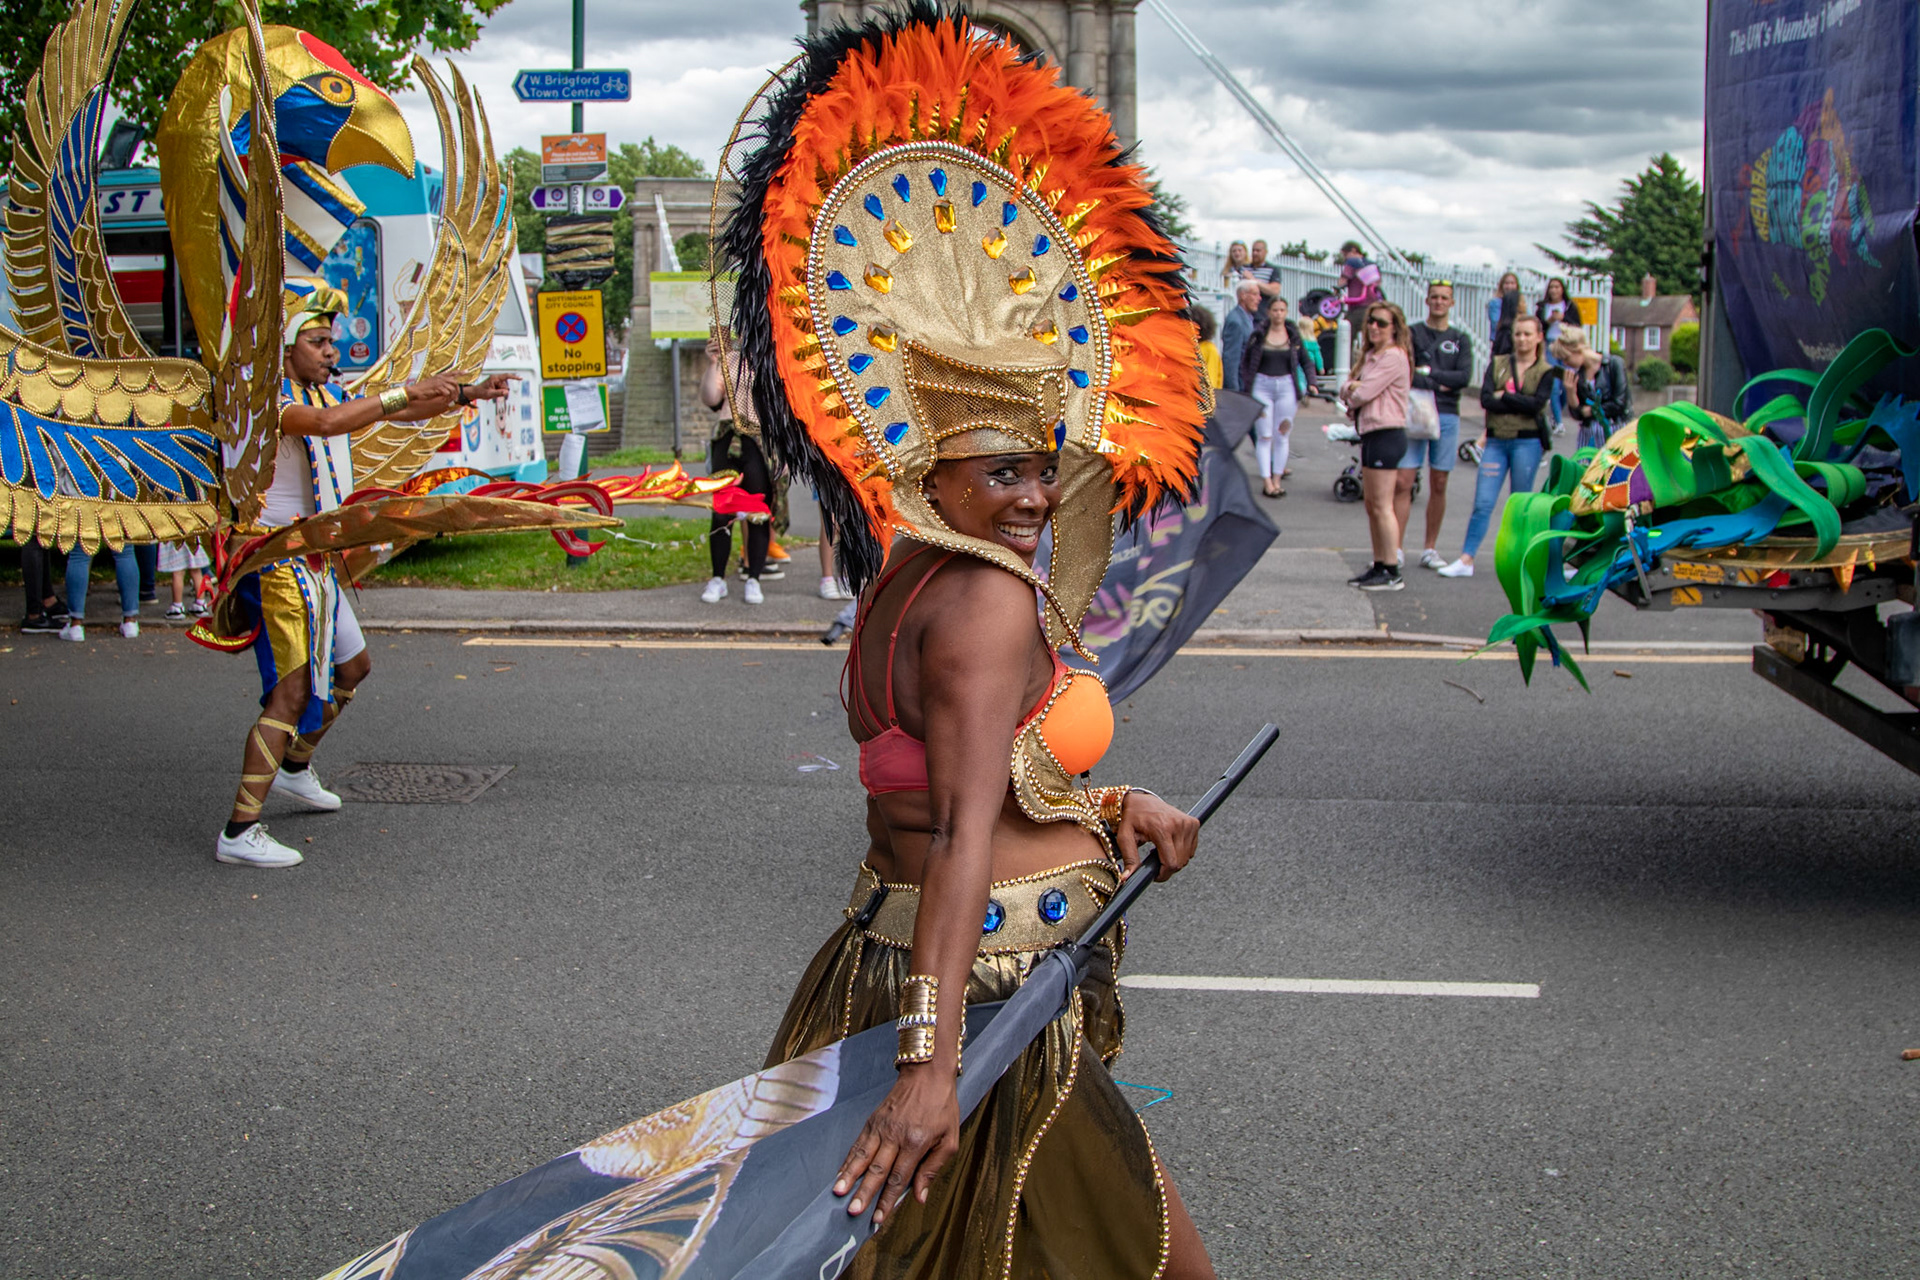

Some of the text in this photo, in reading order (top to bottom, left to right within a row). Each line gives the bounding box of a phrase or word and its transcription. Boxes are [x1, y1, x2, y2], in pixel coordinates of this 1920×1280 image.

[1729, 29, 1746, 56] The
[1747, 21, 1772, 50] UK's
[1773, 11, 1819, 45] Number
[545, 75, 600, 88] Bridgford
[530, 86, 601, 98] Town Centre
[546, 295, 593, 303] NOTTINGHAM
[563, 301, 595, 309] COUNCIL
[564, 348, 582, 359] No
[547, 360, 602, 373] stopping
